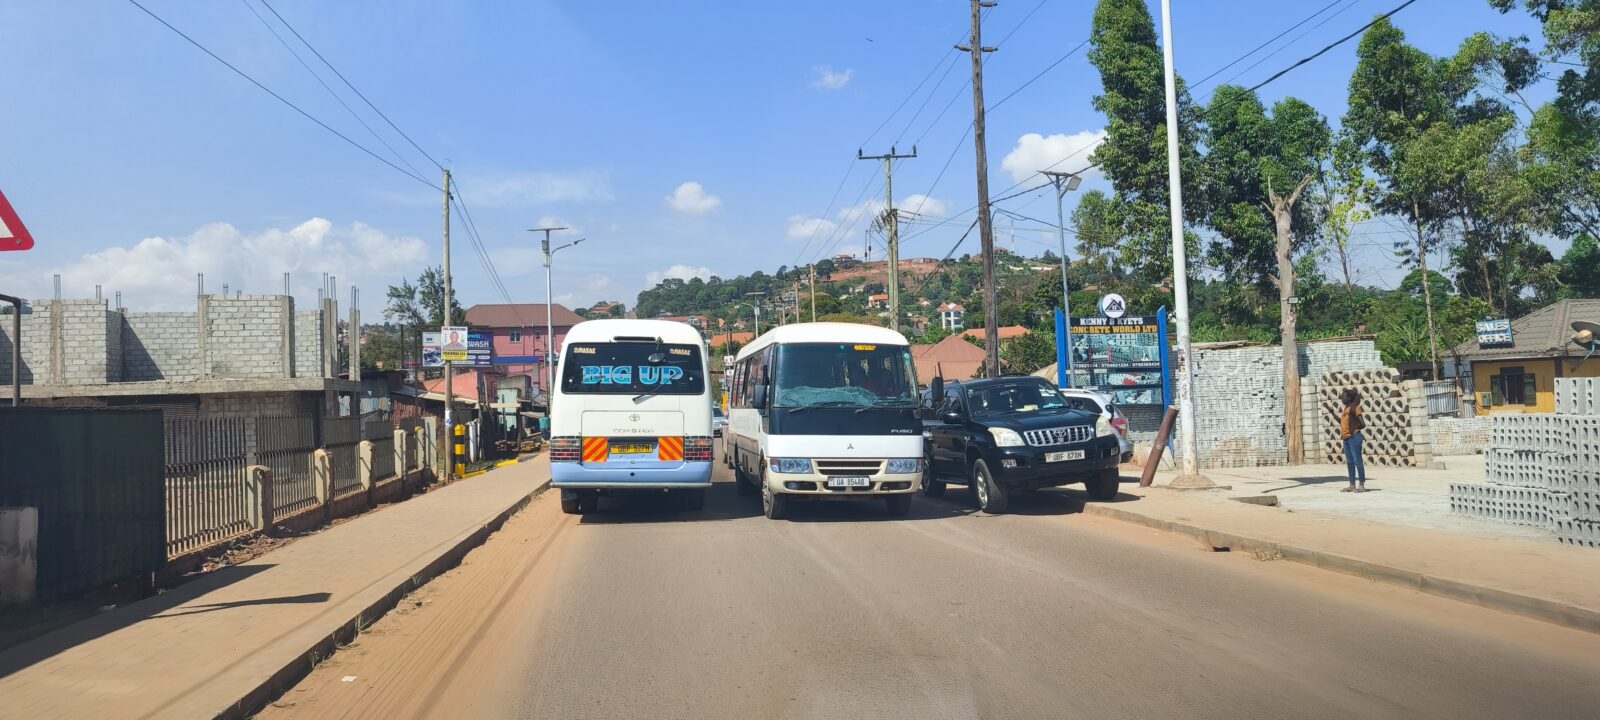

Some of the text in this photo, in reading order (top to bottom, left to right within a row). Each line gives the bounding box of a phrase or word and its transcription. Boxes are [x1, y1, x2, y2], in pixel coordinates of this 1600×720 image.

[1080, 317, 1107, 326] KENNY
[1118, 317, 1143, 325] KYETS
[1112, 325, 1140, 334] WORLD
[1143, 325, 1157, 333] LTD
[1476, 322, 1508, 331] SALES
[1478, 334, 1511, 343] OFFICE
[580, 365, 684, 385] BIG UP
[1053, 452, 1064, 461] UBF
[836, 478, 844, 486] UA
